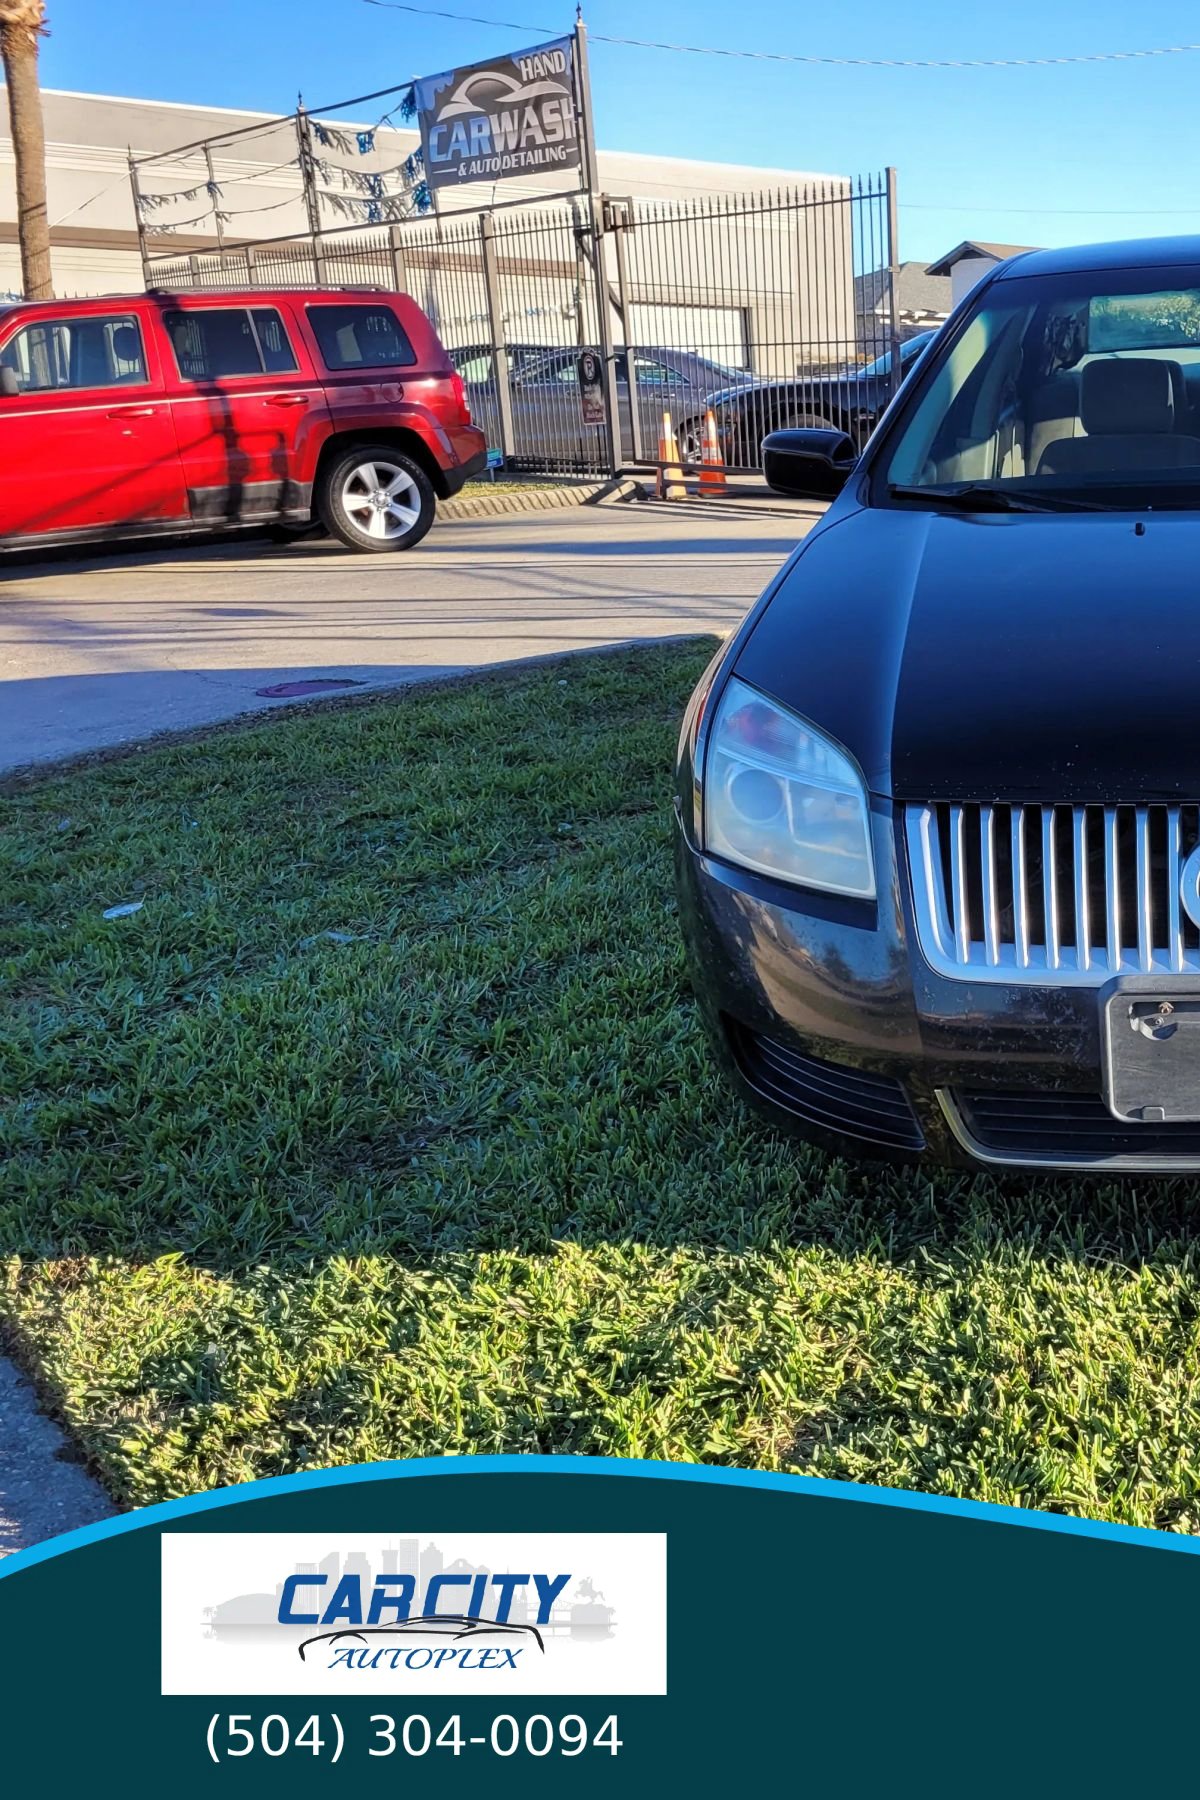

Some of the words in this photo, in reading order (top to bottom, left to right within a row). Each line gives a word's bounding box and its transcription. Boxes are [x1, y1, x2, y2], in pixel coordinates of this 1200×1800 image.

[519, 50, 566, 81] HAND
[458, 162, 467, 176] &
[469, 158, 499, 175] AUTO
[502, 145, 567, 170] DETAILING
